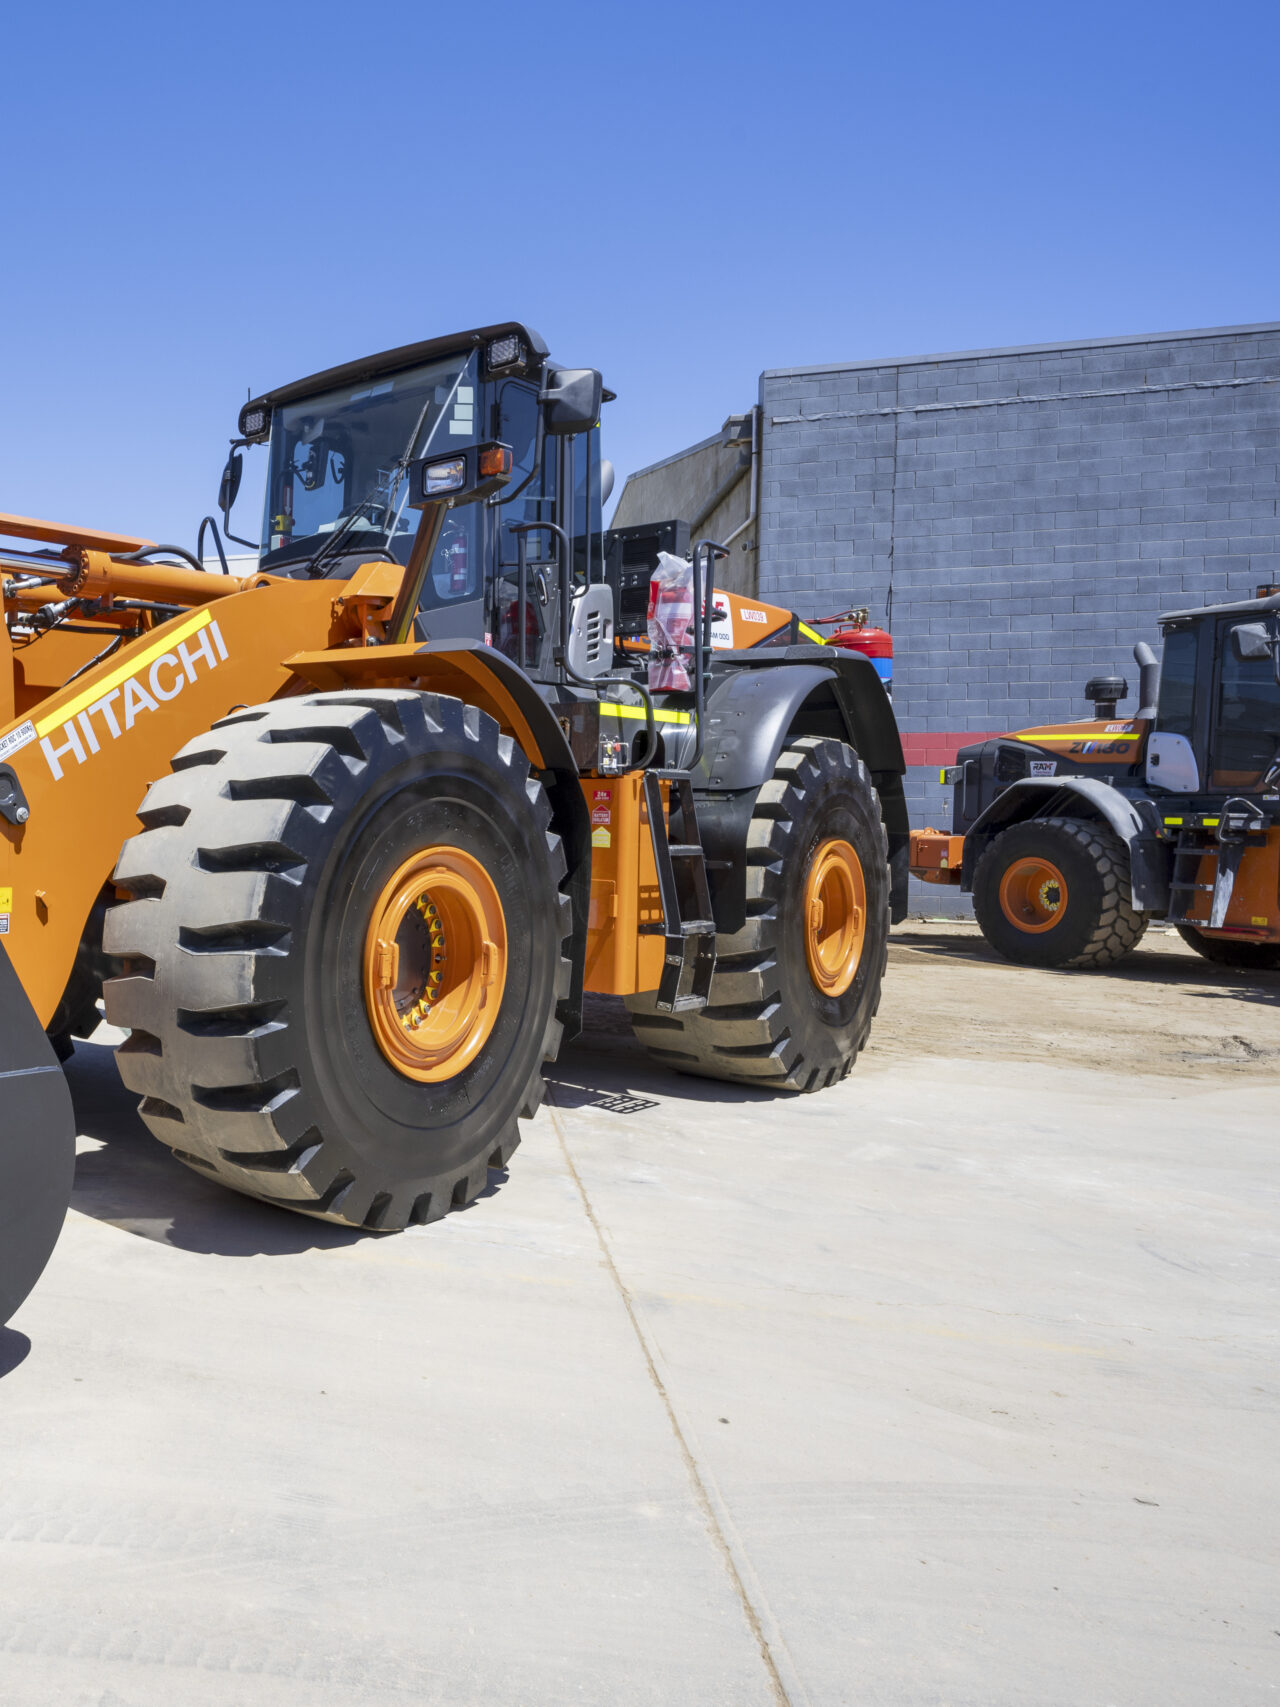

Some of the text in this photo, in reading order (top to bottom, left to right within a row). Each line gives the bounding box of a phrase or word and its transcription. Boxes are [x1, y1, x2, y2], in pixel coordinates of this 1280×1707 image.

[39, 619, 229, 781] HITACHI
[1069, 741, 1130, 754] ZW180
[1033, 763, 1053, 771] RAM
